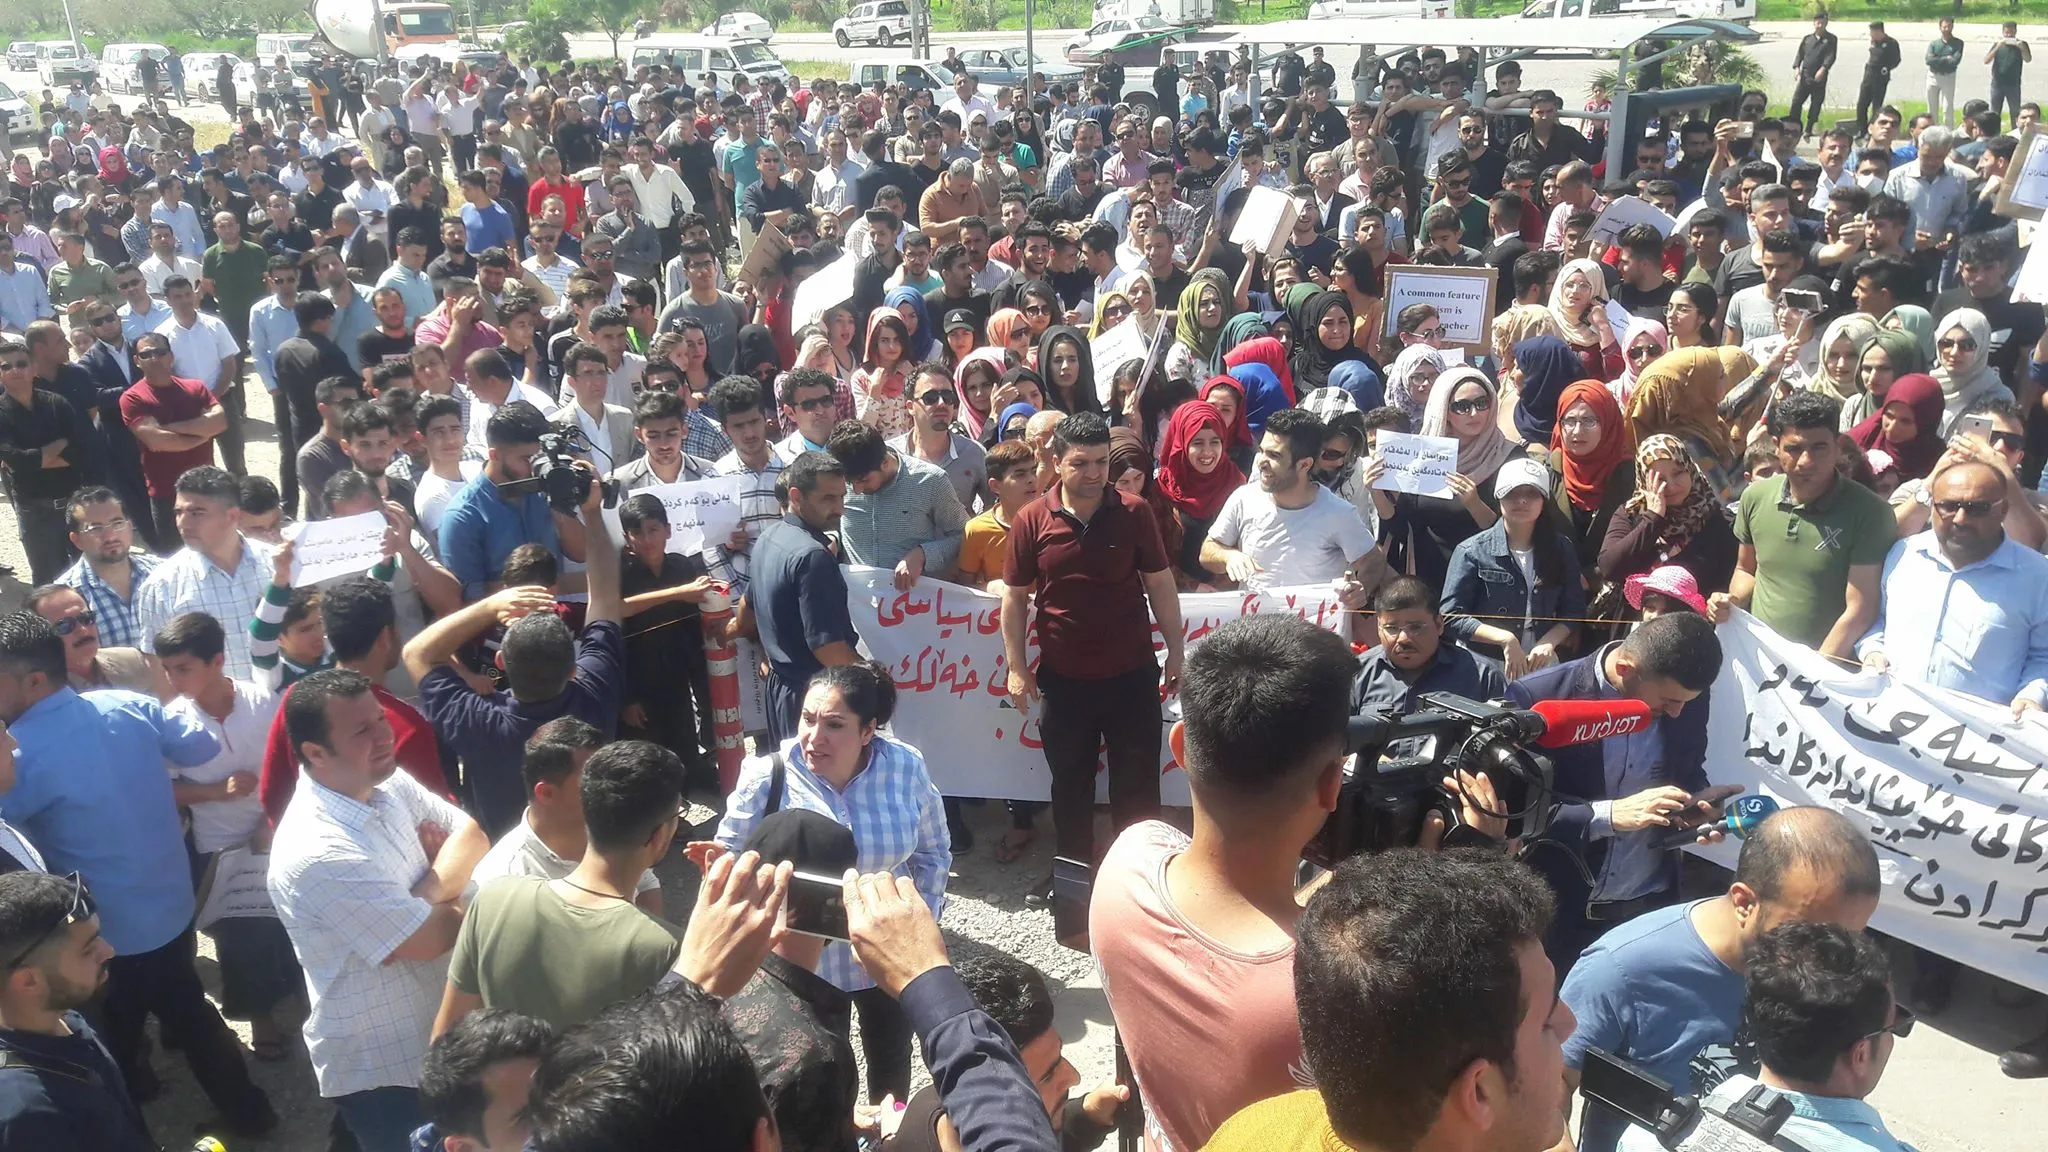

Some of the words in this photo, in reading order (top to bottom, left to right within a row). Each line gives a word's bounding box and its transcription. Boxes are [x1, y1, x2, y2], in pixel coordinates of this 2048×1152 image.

[1398, 288, 1405, 297] A
[1407, 290, 1446, 298] common
[1448, 290, 1481, 300] feature
[1437, 305, 1452, 314] ism
[1455, 306, 1462, 314] is
[1440, 321, 1470, 330] eacher
